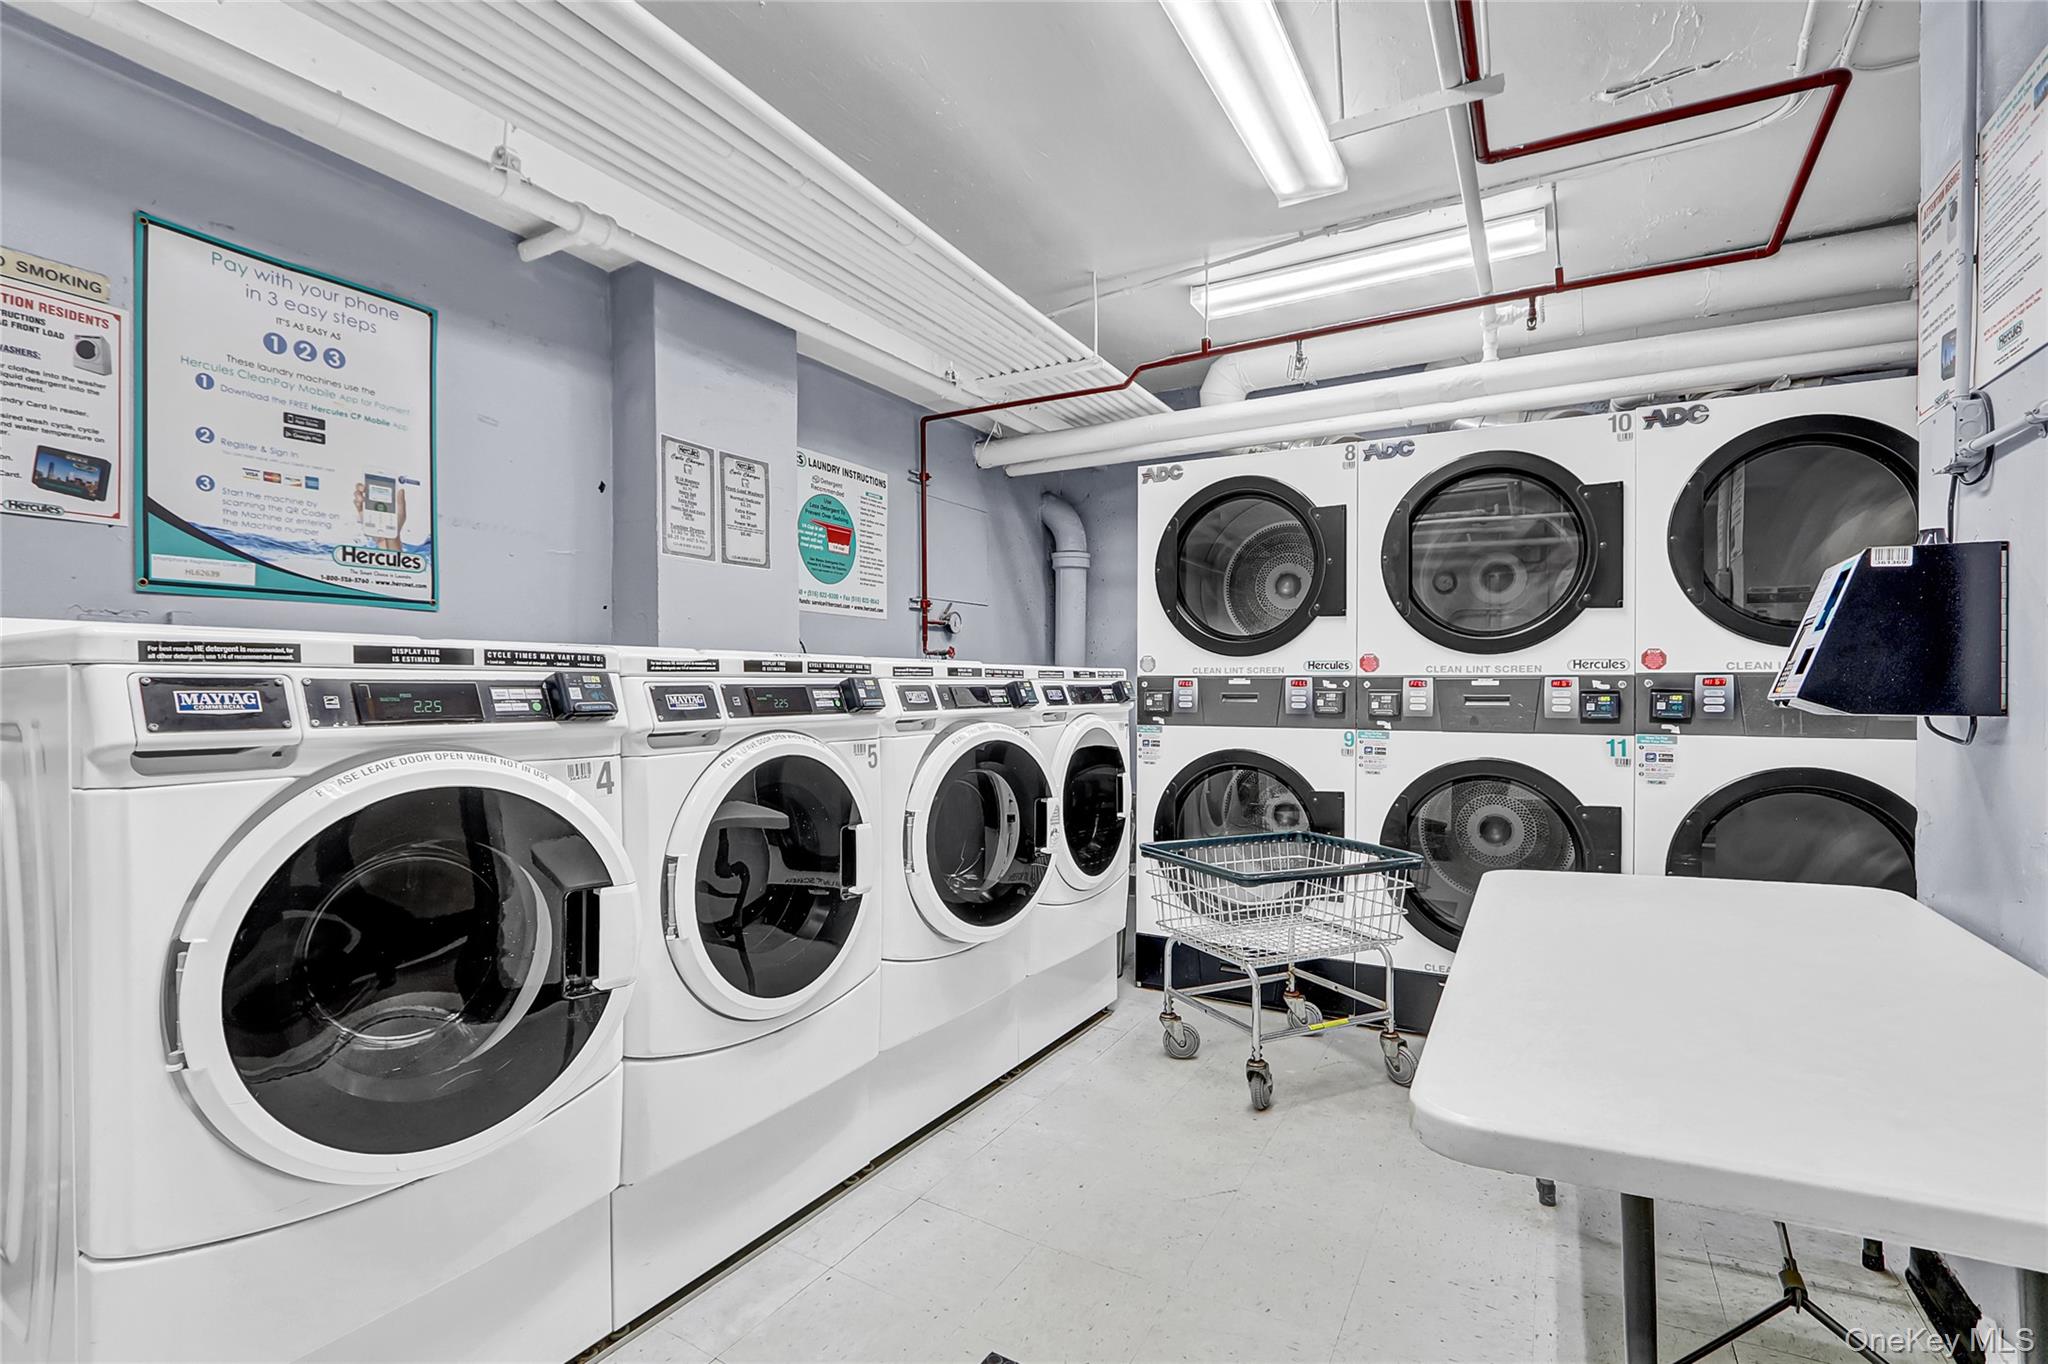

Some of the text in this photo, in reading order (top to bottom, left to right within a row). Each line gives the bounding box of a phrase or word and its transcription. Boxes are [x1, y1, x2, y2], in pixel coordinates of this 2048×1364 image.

[16, 261, 102, 293] SMOKING
[211, 251, 399, 321] Pay with your phone
[39, 301, 110, 330] RESIDENTS
[246, 284, 377, 334] in 3 easy steps
[11, 321, 65, 340] FRONT LOAD
[276, 317, 341, 341] IT'S AS EASY AS
[8, 365, 41, 376] clothes
[43, 371, 60, 380] into
[62, 375, 75, 383] the
[77, 380, 107, 389] washer
[180, 355, 234, 376] Hercules
[237, 369, 295, 392] CleanPay
[298, 385, 336, 399] Mobile
[339, 395, 359, 404] App
[227, 354, 376, 396] These laundry machines use the
[25, 376, 100, 396] detergent into the
[26, 401, 89, 418] Card in reader.
[220, 384, 269, 402] Download
[272, 396, 287, 405] the
[289, 400, 309, 411] FREE
[311, 404, 348, 418] Hercules
[350, 412, 361, 420] CP
[364, 416, 390, 427] Mobile
[26, 417, 99, 435] wash cycle, cycle
[1608, 413, 1632, 432] 10
[1642, 404, 1710, 430] ADC
[14, 423, 39, 432] water
[41, 428, 92, 441] temperature
[220, 438, 258, 452] Register
[261, 444, 267, 453] &
[270, 446, 290, 459] Sign
[1344, 444, 1355, 461] 8
[1363, 440, 1415, 461] ADC
[808, 458, 887, 489] LAUNDRY INSTRUCTIONS
[820, 477, 843, 489] Detergent
[1142, 464, 1184, 484] ADC
[222, 488, 244, 496] Start
[246, 491, 262, 500] the
[264, 495, 304, 507] machine
[307, 500, 317, 508] by
[811, 483, 845, 498] Recommended
[8, 500, 61, 515] Hercules
[222, 499, 266, 511] scanning
[268, 504, 282, 512] the
[285, 506, 298, 514] QR
[301, 508, 327, 519] Code
[820, 504, 840, 514] Detergent
[222, 508, 238, 517] the
[242, 511, 282, 524] Machine
[296, 517, 332, 529] entering
[222, 518, 238, 527] the
[241, 520, 282, 532] Machine
[342, 546, 421, 570] Hercules
[487, 651, 511, 659] CYCLE
[1246, 666, 1284, 674] SCREEN
[1307, 661, 1349, 670] Hercules
[1425, 665, 1542, 673] CLEAN LINT SCREEN
[1572, 660, 1626, 670] Hercules
[1726, 661, 1774, 670] CLEAN
[179, 692, 257, 706] MAYTAG
[414, 700, 442, 713] 2.25
[669, 694, 703, 705] MAYTAG
[757, 736, 772, 746] DOOR
[1344, 731, 1355, 748] 9
[1606, 739, 1627, 757] 11
[868, 743, 878, 769] 5
[360, 752, 550, 782] LEAVE DOOR OPEN WHEN NOT IN USE
[596, 761, 615, 794] 4
